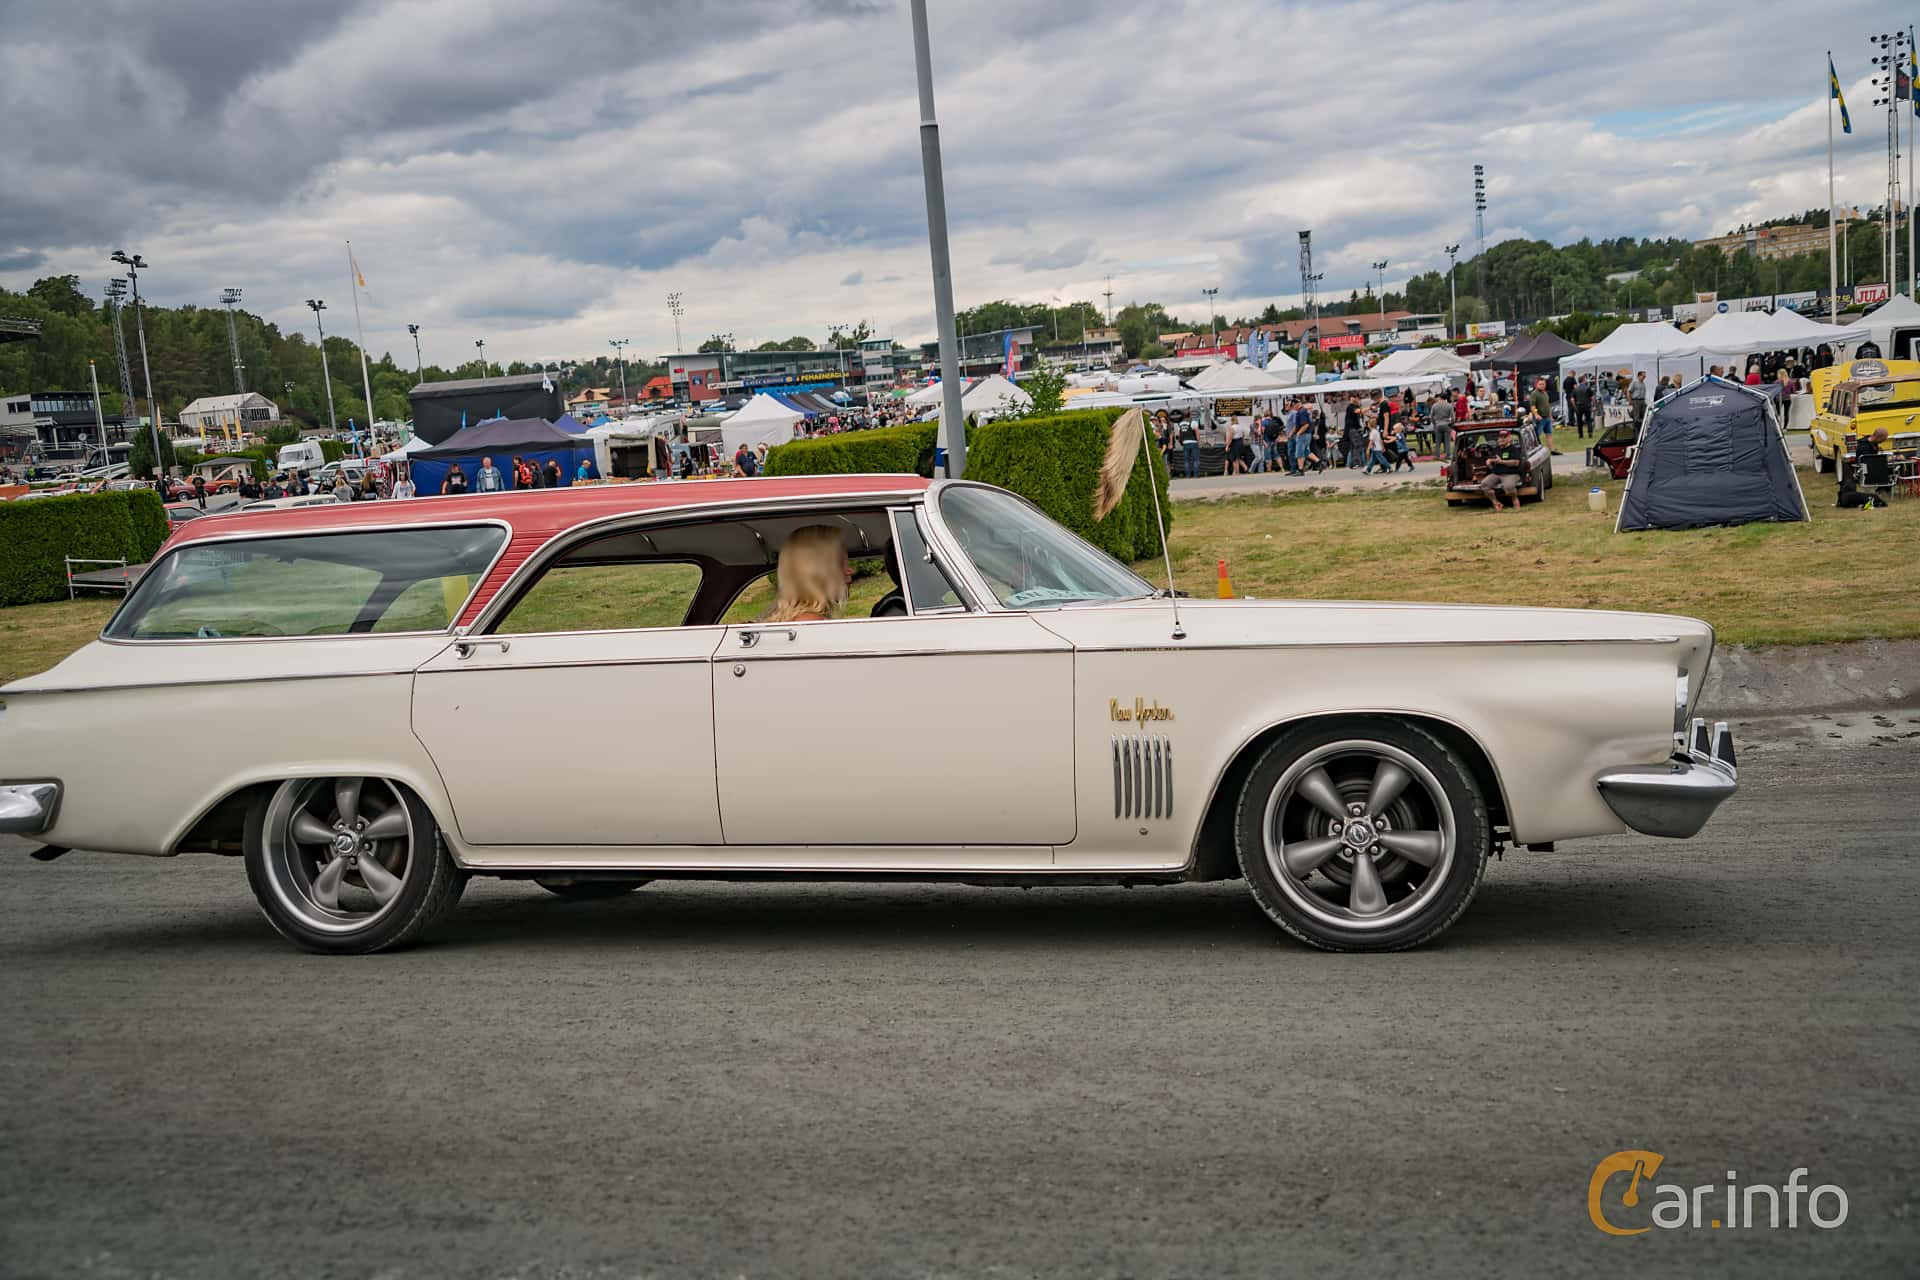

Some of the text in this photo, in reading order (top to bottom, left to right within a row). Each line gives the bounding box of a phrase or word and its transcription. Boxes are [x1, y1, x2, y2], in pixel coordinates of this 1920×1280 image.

[1857, 288, 1887, 303] JULA
[1109, 696, 1175, 729] New Yorker
